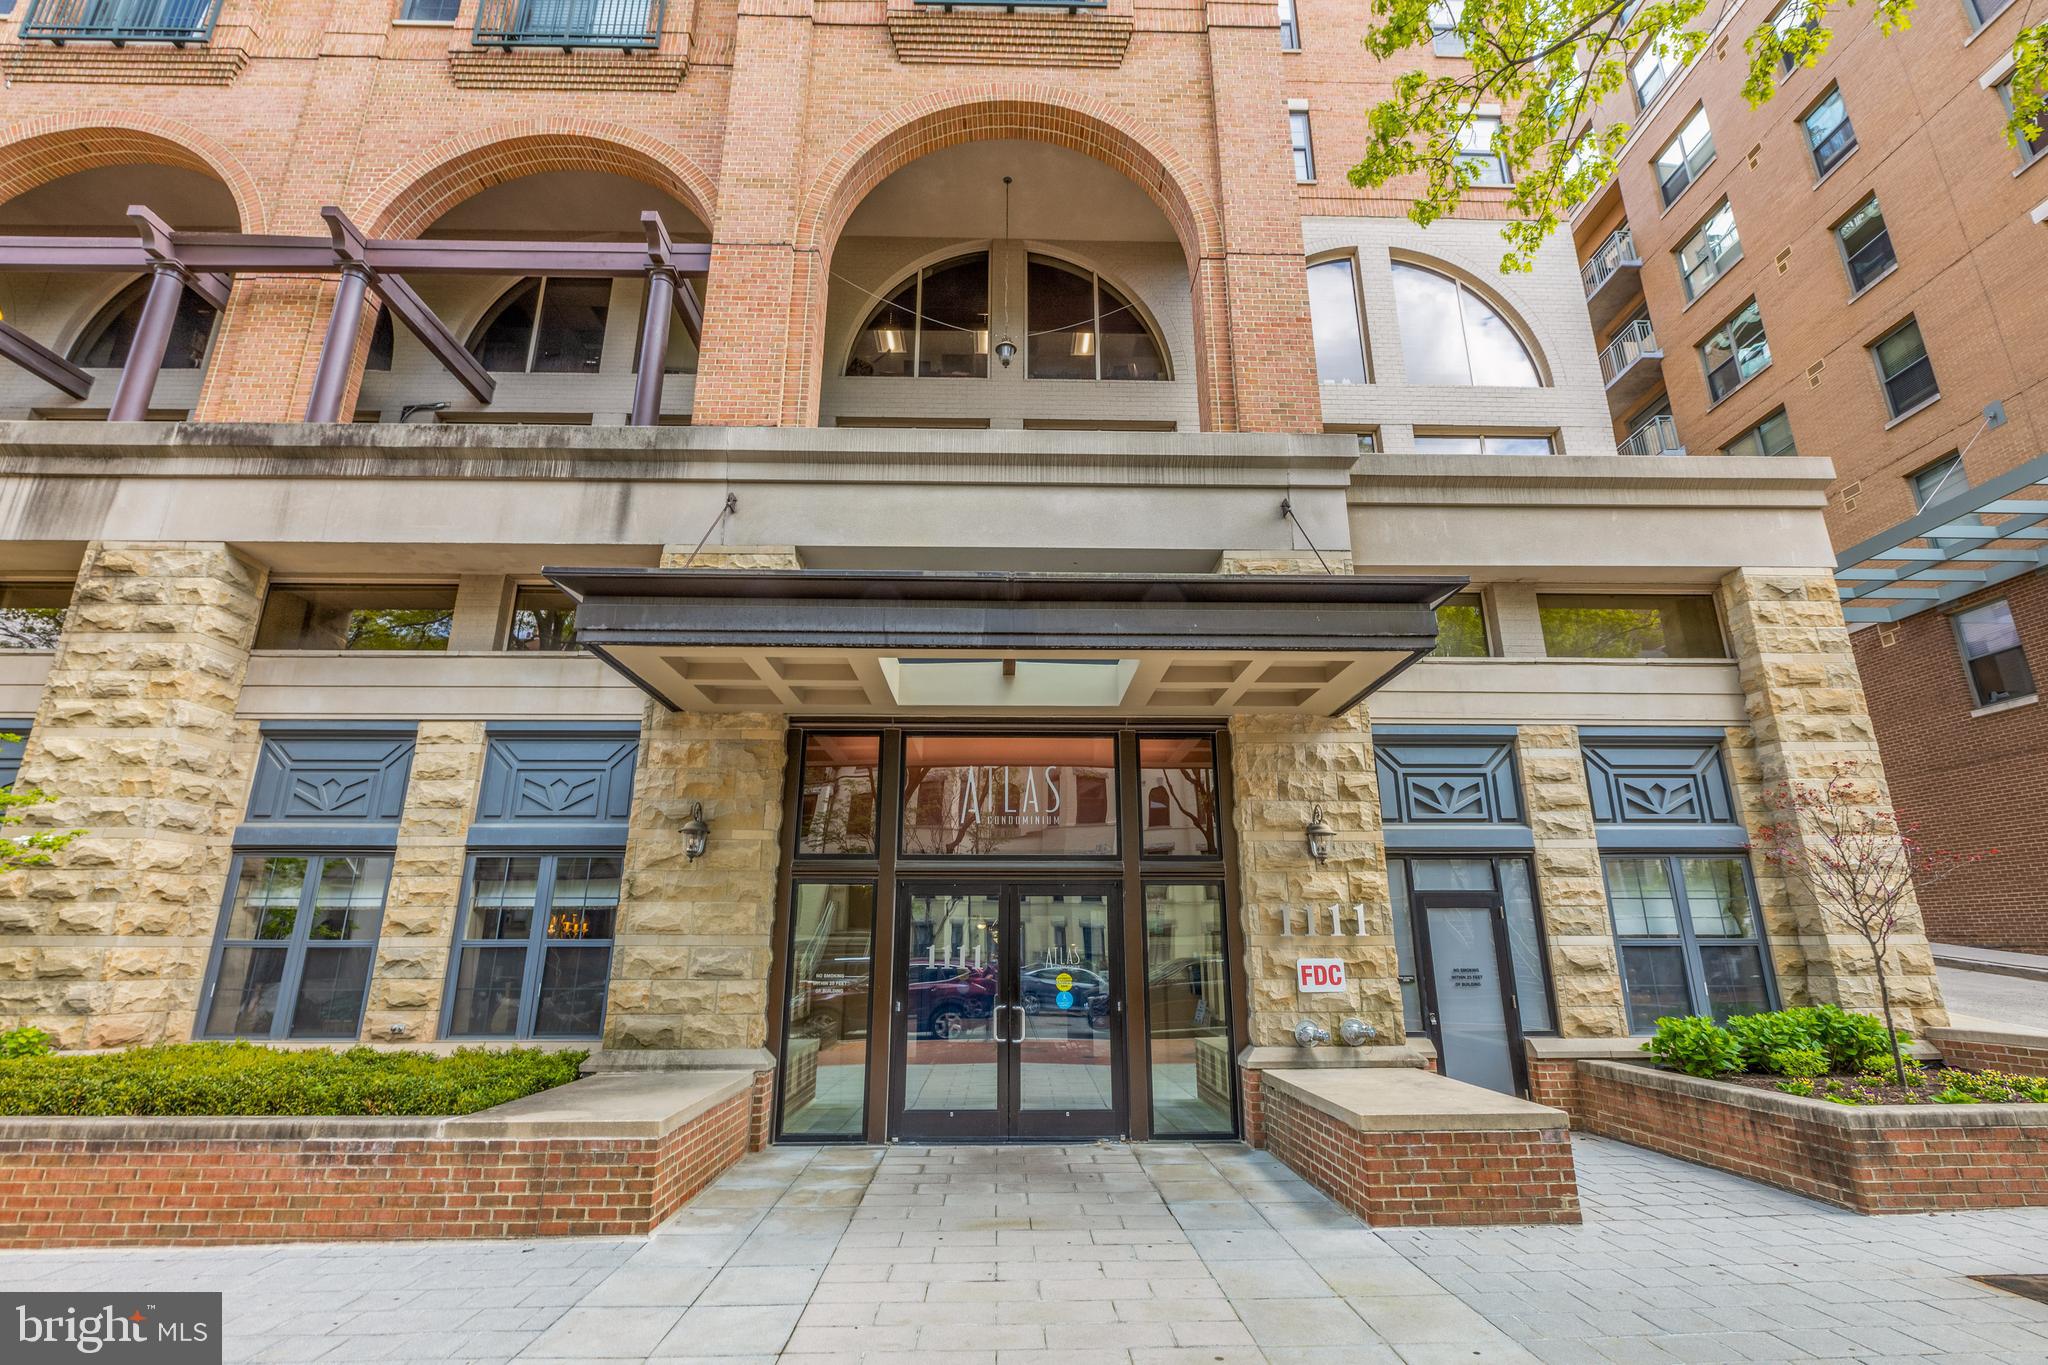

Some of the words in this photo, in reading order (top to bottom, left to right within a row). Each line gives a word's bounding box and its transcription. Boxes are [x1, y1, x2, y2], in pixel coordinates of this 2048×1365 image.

[961, 766, 1060, 824] ATLAS
[987, 815, 1061, 825] CONDOMINIUM
[1280, 903, 1371, 937] 1111
[926, 944, 983, 969] 1111
[1045, 947, 1081, 969] ATLAS
[1300, 964, 1342, 986] FDC
